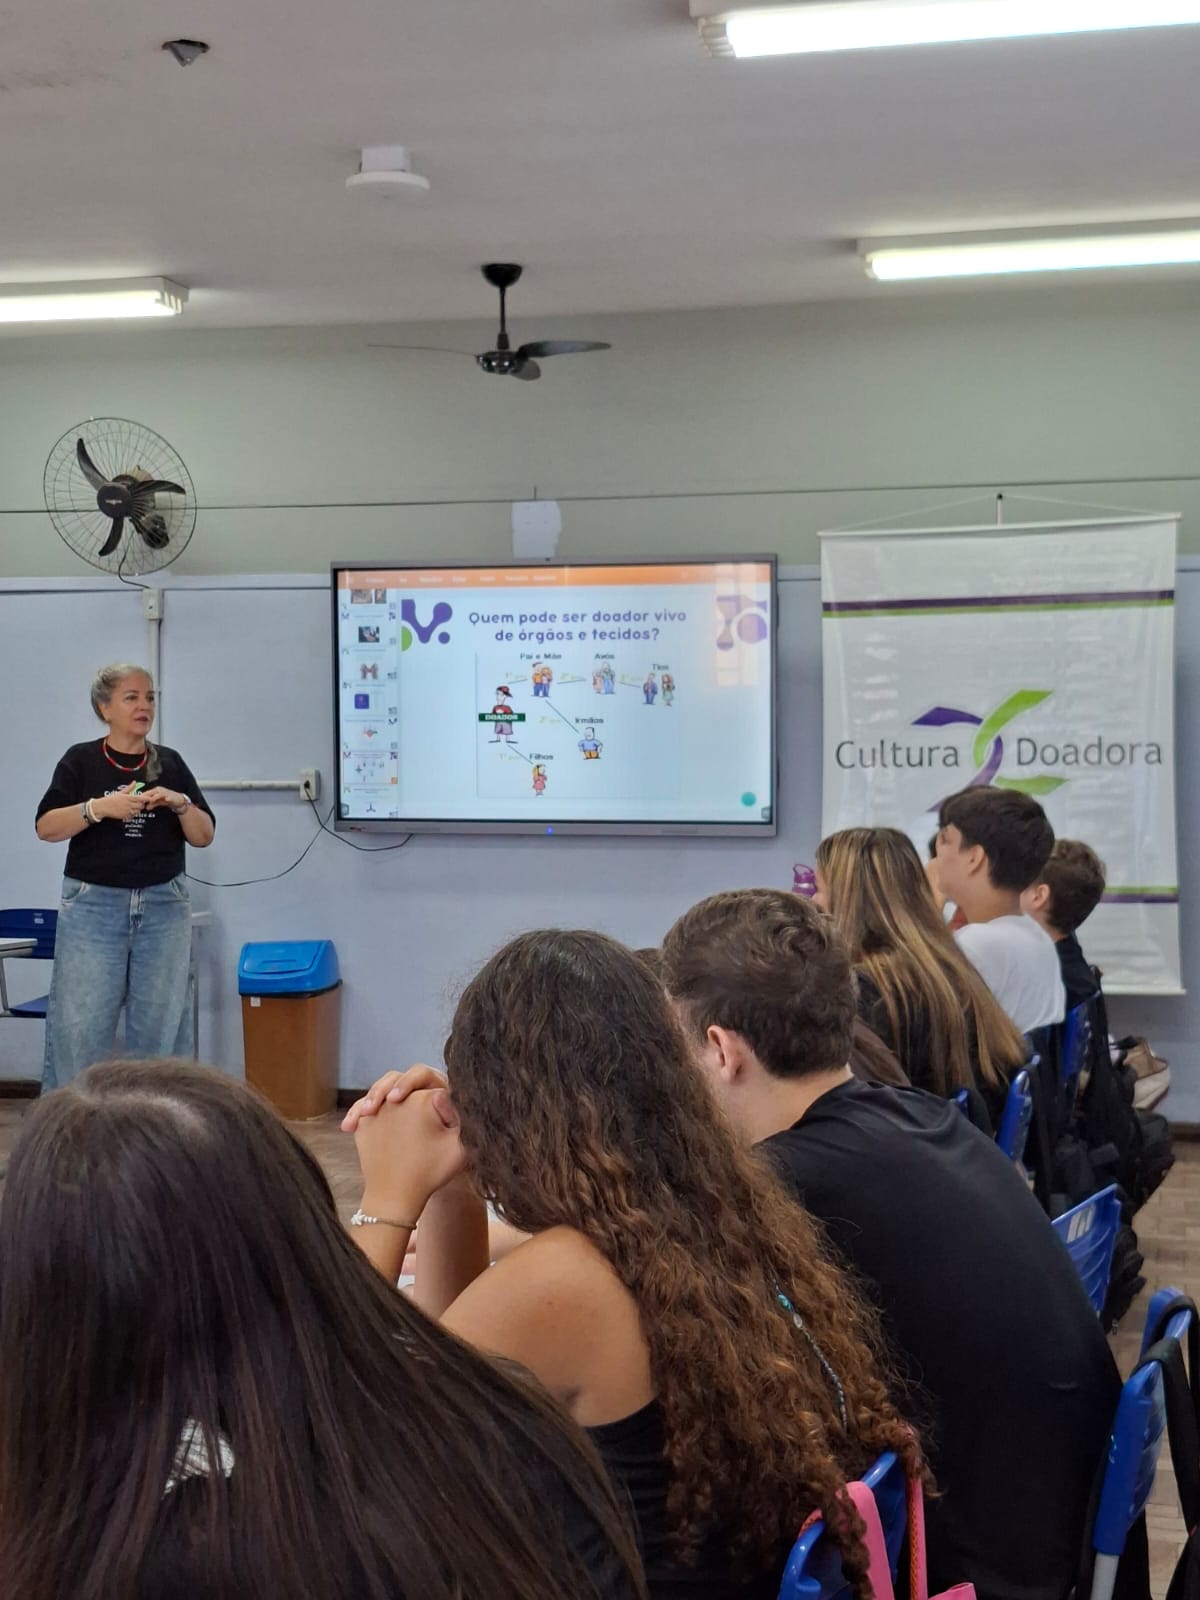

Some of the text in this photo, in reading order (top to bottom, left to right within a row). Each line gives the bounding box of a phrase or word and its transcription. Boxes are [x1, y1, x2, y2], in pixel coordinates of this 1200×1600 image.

[468, 609, 687, 627] Quem pode ser doador vivo
[495, 627, 660, 644] de órgãos e tecidos?
[484, 713, 519, 721] DOADOR
[835, 736, 1163, 769] Cultura Doadora
